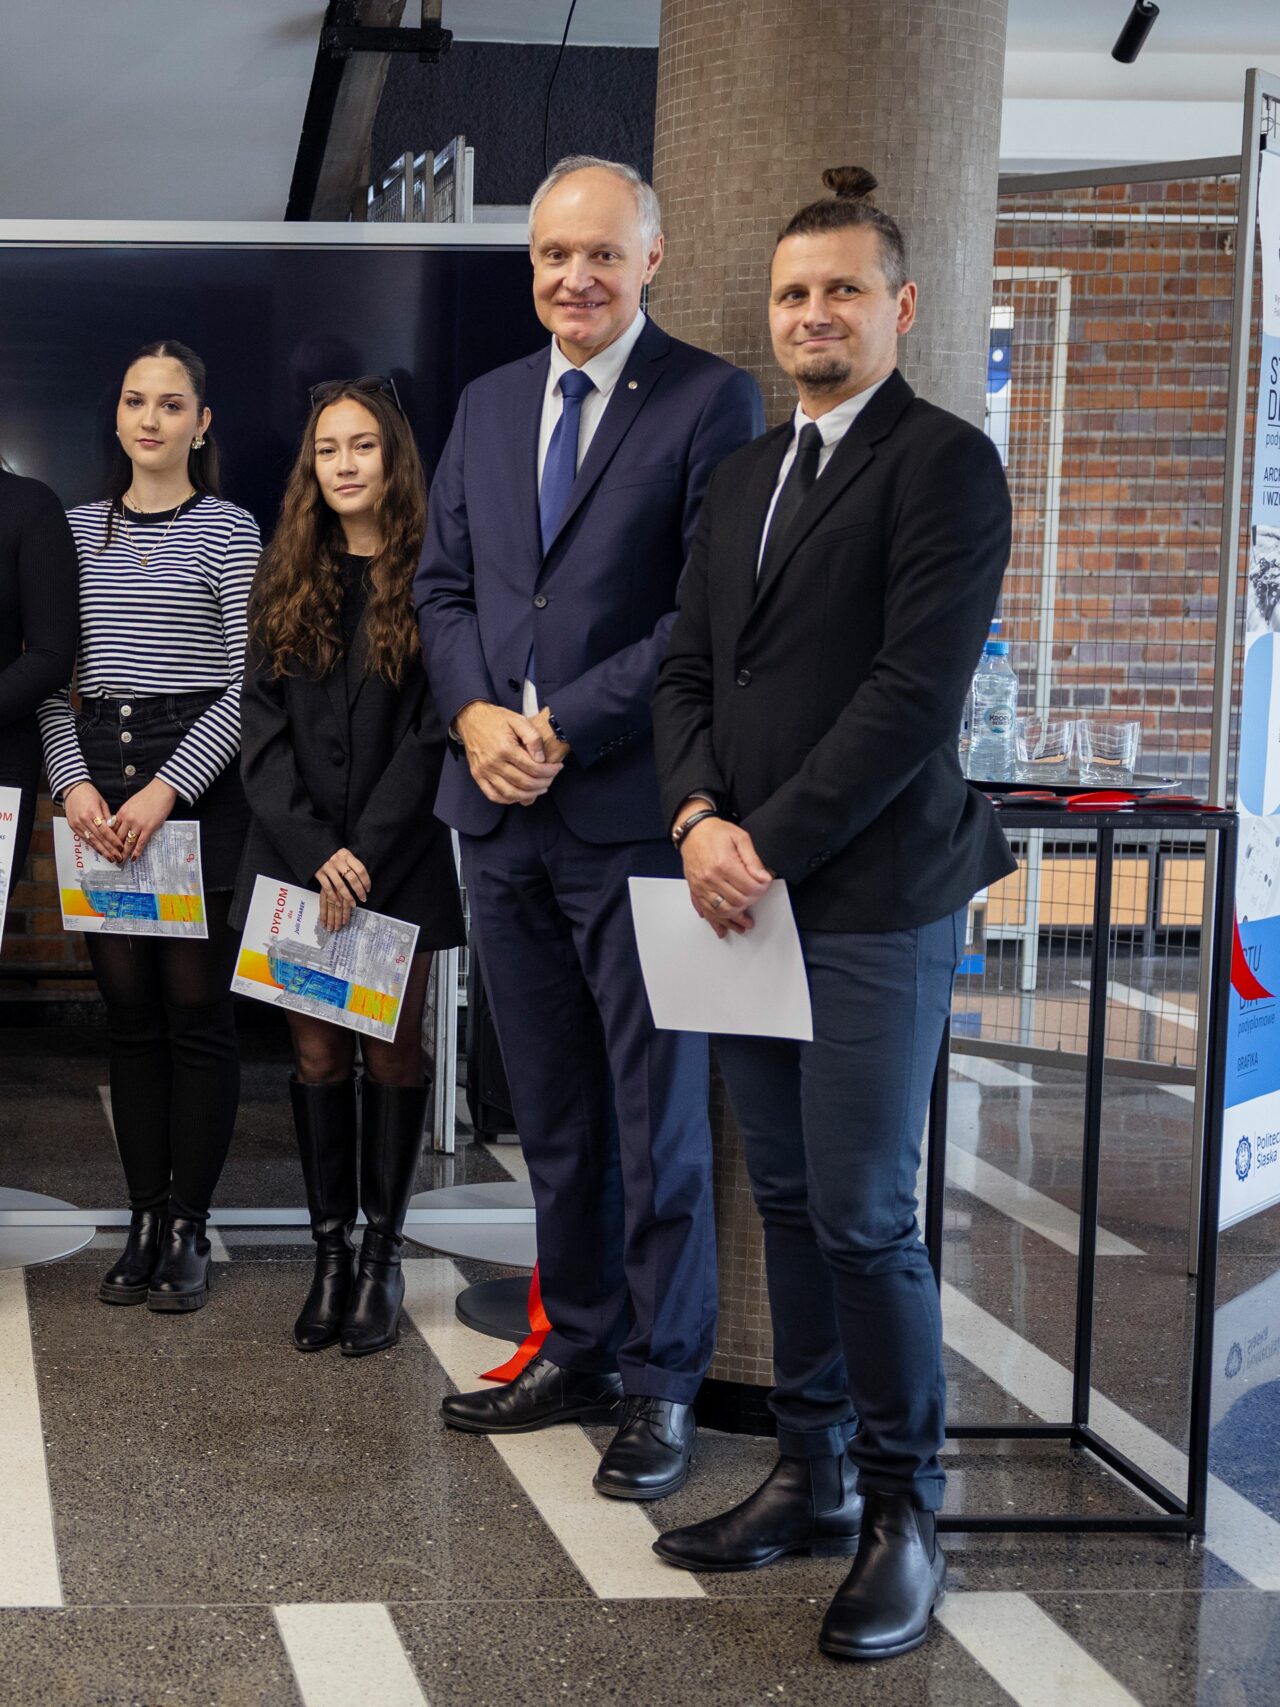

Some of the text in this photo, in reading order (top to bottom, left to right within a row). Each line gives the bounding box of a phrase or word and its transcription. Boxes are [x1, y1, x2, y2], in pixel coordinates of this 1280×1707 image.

[1271, 356, 1280, 385] S
[73, 833, 84, 869] DYPLO
[270, 887, 289, 935] DYPLOM
[1237, 1052, 1259, 1072] GRAFIKA
[1257, 1131, 1280, 1151] Politec
